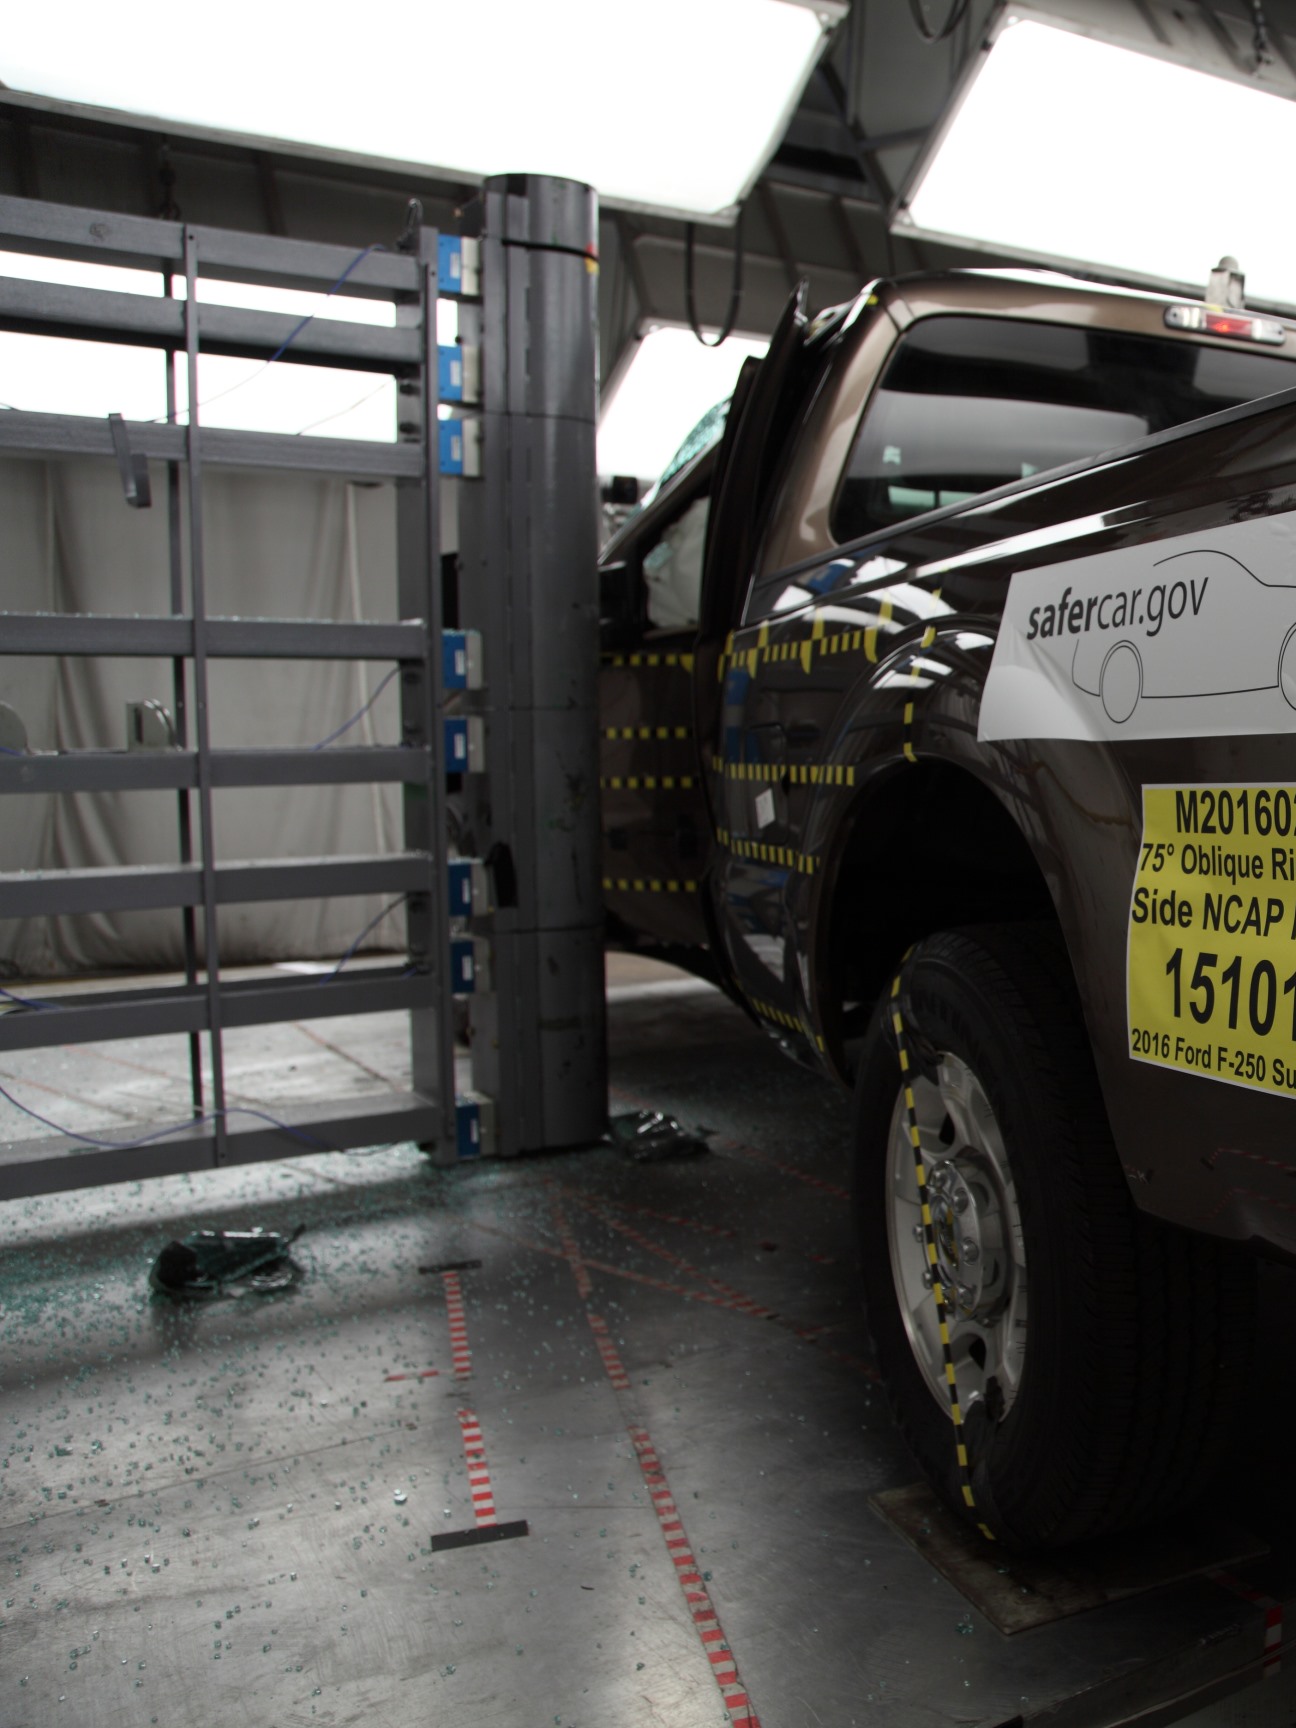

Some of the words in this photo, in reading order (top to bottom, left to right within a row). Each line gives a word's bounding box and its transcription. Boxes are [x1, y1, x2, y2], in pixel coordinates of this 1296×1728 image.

[1027, 577, 1209, 640] safercar.gov
[1181, 844, 1263, 885] Oblique
[1132, 887, 1192, 928] Side
[1202, 893, 1284, 937] NCAP
[1132, 1028, 1170, 1058] 2016
[1175, 1037, 1211, 1069] Ford
[1218, 1047, 1266, 1082] F-250
